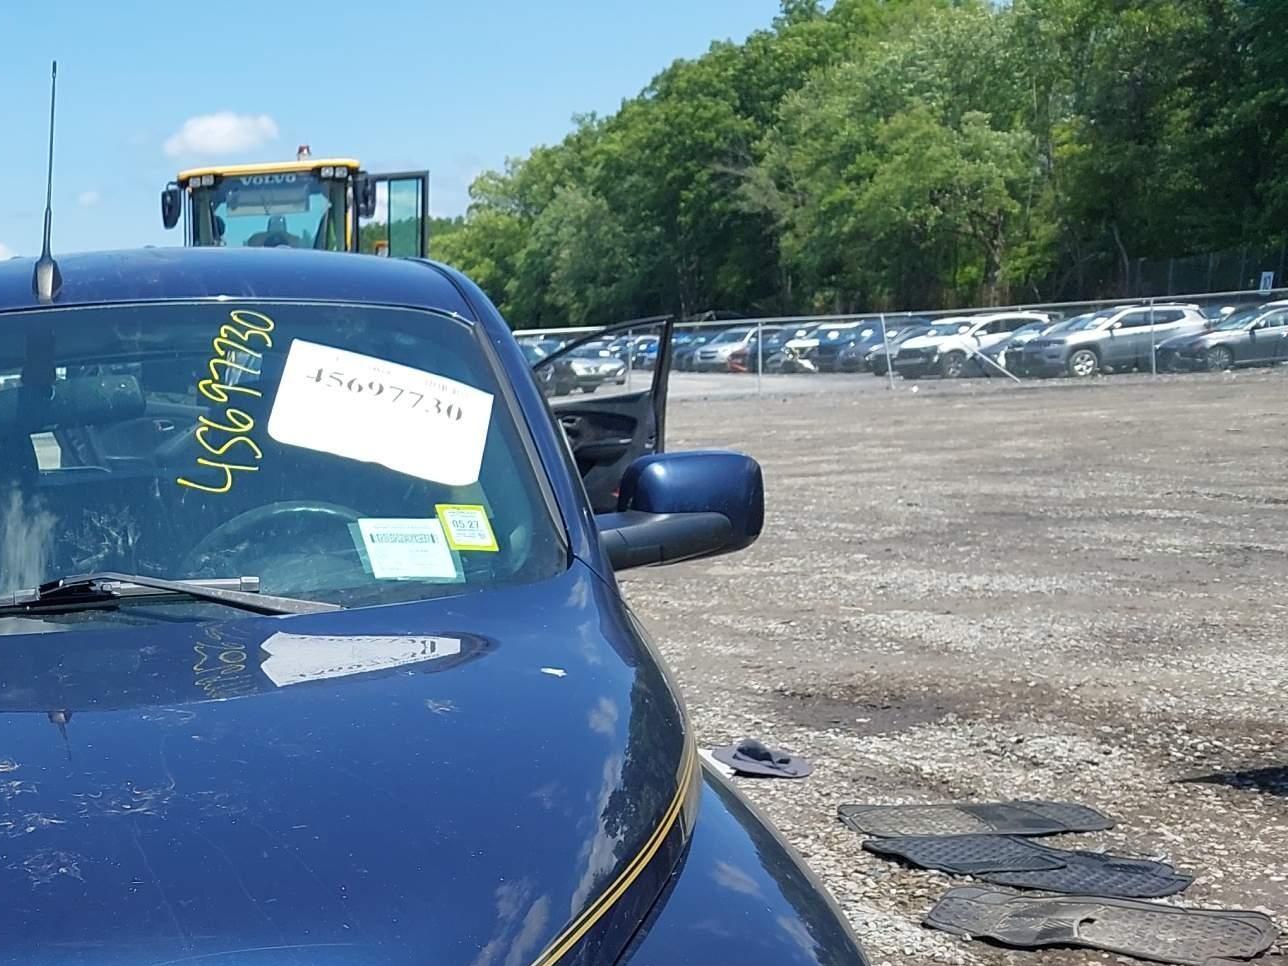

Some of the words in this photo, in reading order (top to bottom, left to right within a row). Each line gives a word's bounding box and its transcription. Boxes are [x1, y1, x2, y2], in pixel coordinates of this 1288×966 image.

[240, 174, 296, 185] VOLVO
[176, 310, 274, 492] 45697730
[305, 367, 463, 421] 45697730
